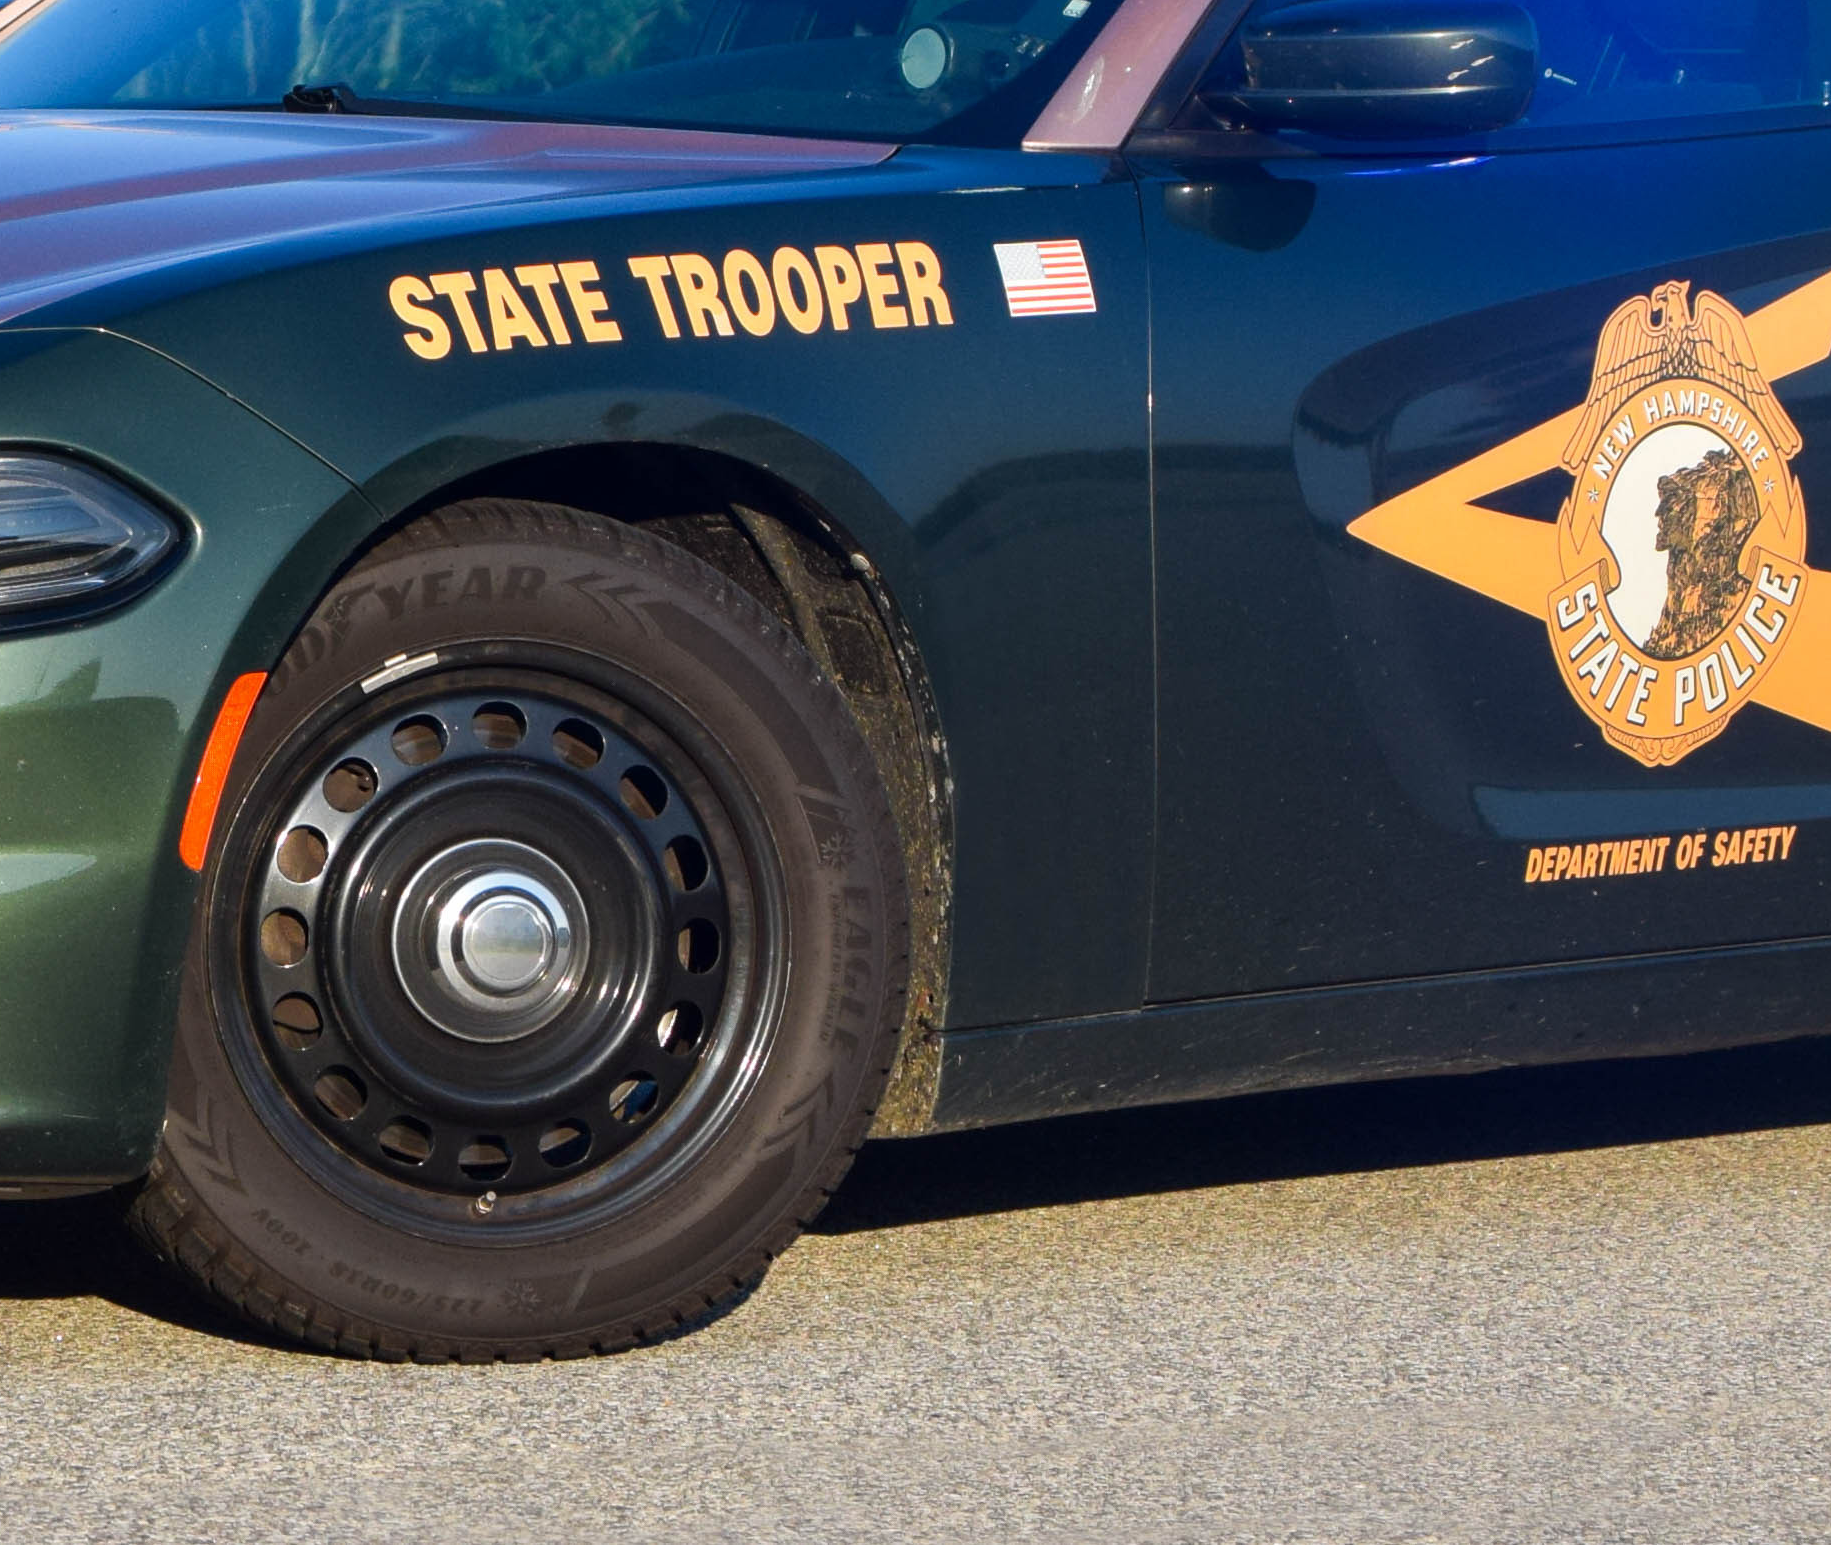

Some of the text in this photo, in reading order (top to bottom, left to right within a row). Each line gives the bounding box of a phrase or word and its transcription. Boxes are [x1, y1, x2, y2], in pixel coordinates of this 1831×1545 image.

[388, 241, 954, 360] STATE TROOPER
[1592, 390, 1770, 480] NEW HAMPSHIRE
[1556, 563, 1802, 726] STATE POLICE
[1524, 825, 1797, 883] DEPARTMENT OF SAFETY
